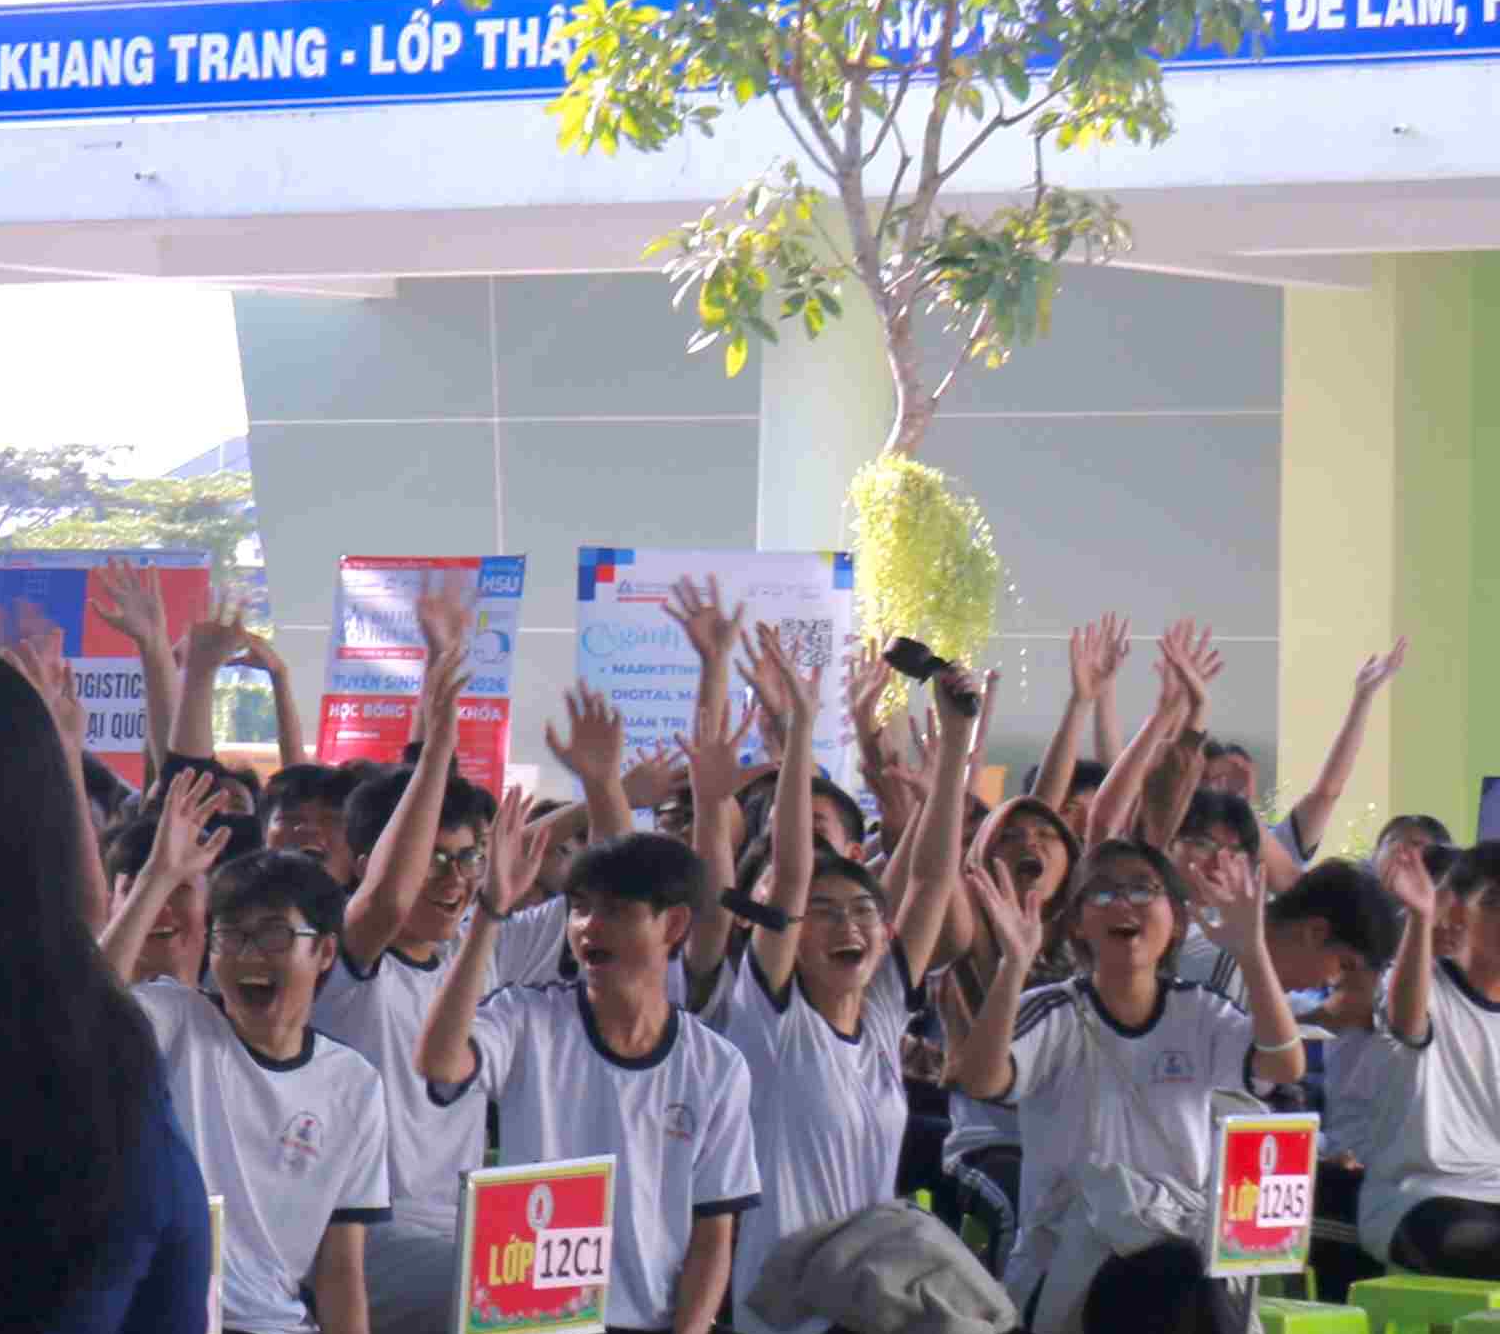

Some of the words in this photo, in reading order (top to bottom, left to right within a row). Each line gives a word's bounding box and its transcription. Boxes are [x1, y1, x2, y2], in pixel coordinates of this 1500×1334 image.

[168, 27, 328, 84] TRANG
[368, 8, 463, 74] LỚP
[475, 4, 585, 70] THÂ
[72, 672, 143, 700] OGISTIC
[488, 1232, 535, 1286] LỚP
[540, 1236, 605, 1279] 12C1
